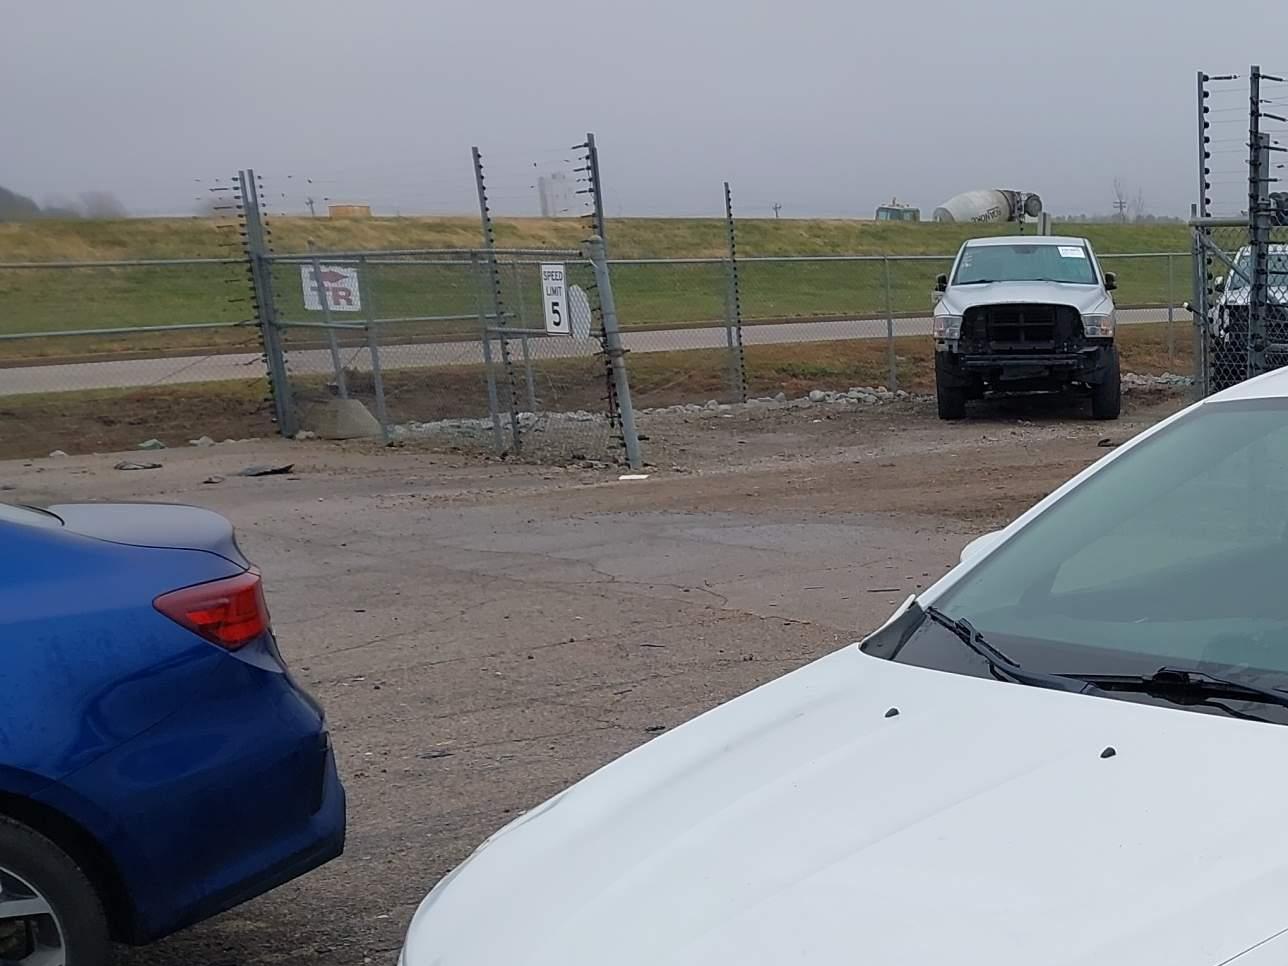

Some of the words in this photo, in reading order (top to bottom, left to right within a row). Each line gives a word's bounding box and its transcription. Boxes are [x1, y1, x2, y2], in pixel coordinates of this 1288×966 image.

[543, 270, 563, 281] SPEED
[546, 286, 562, 296] LIMIT
[551, 301, 562, 326] 5
